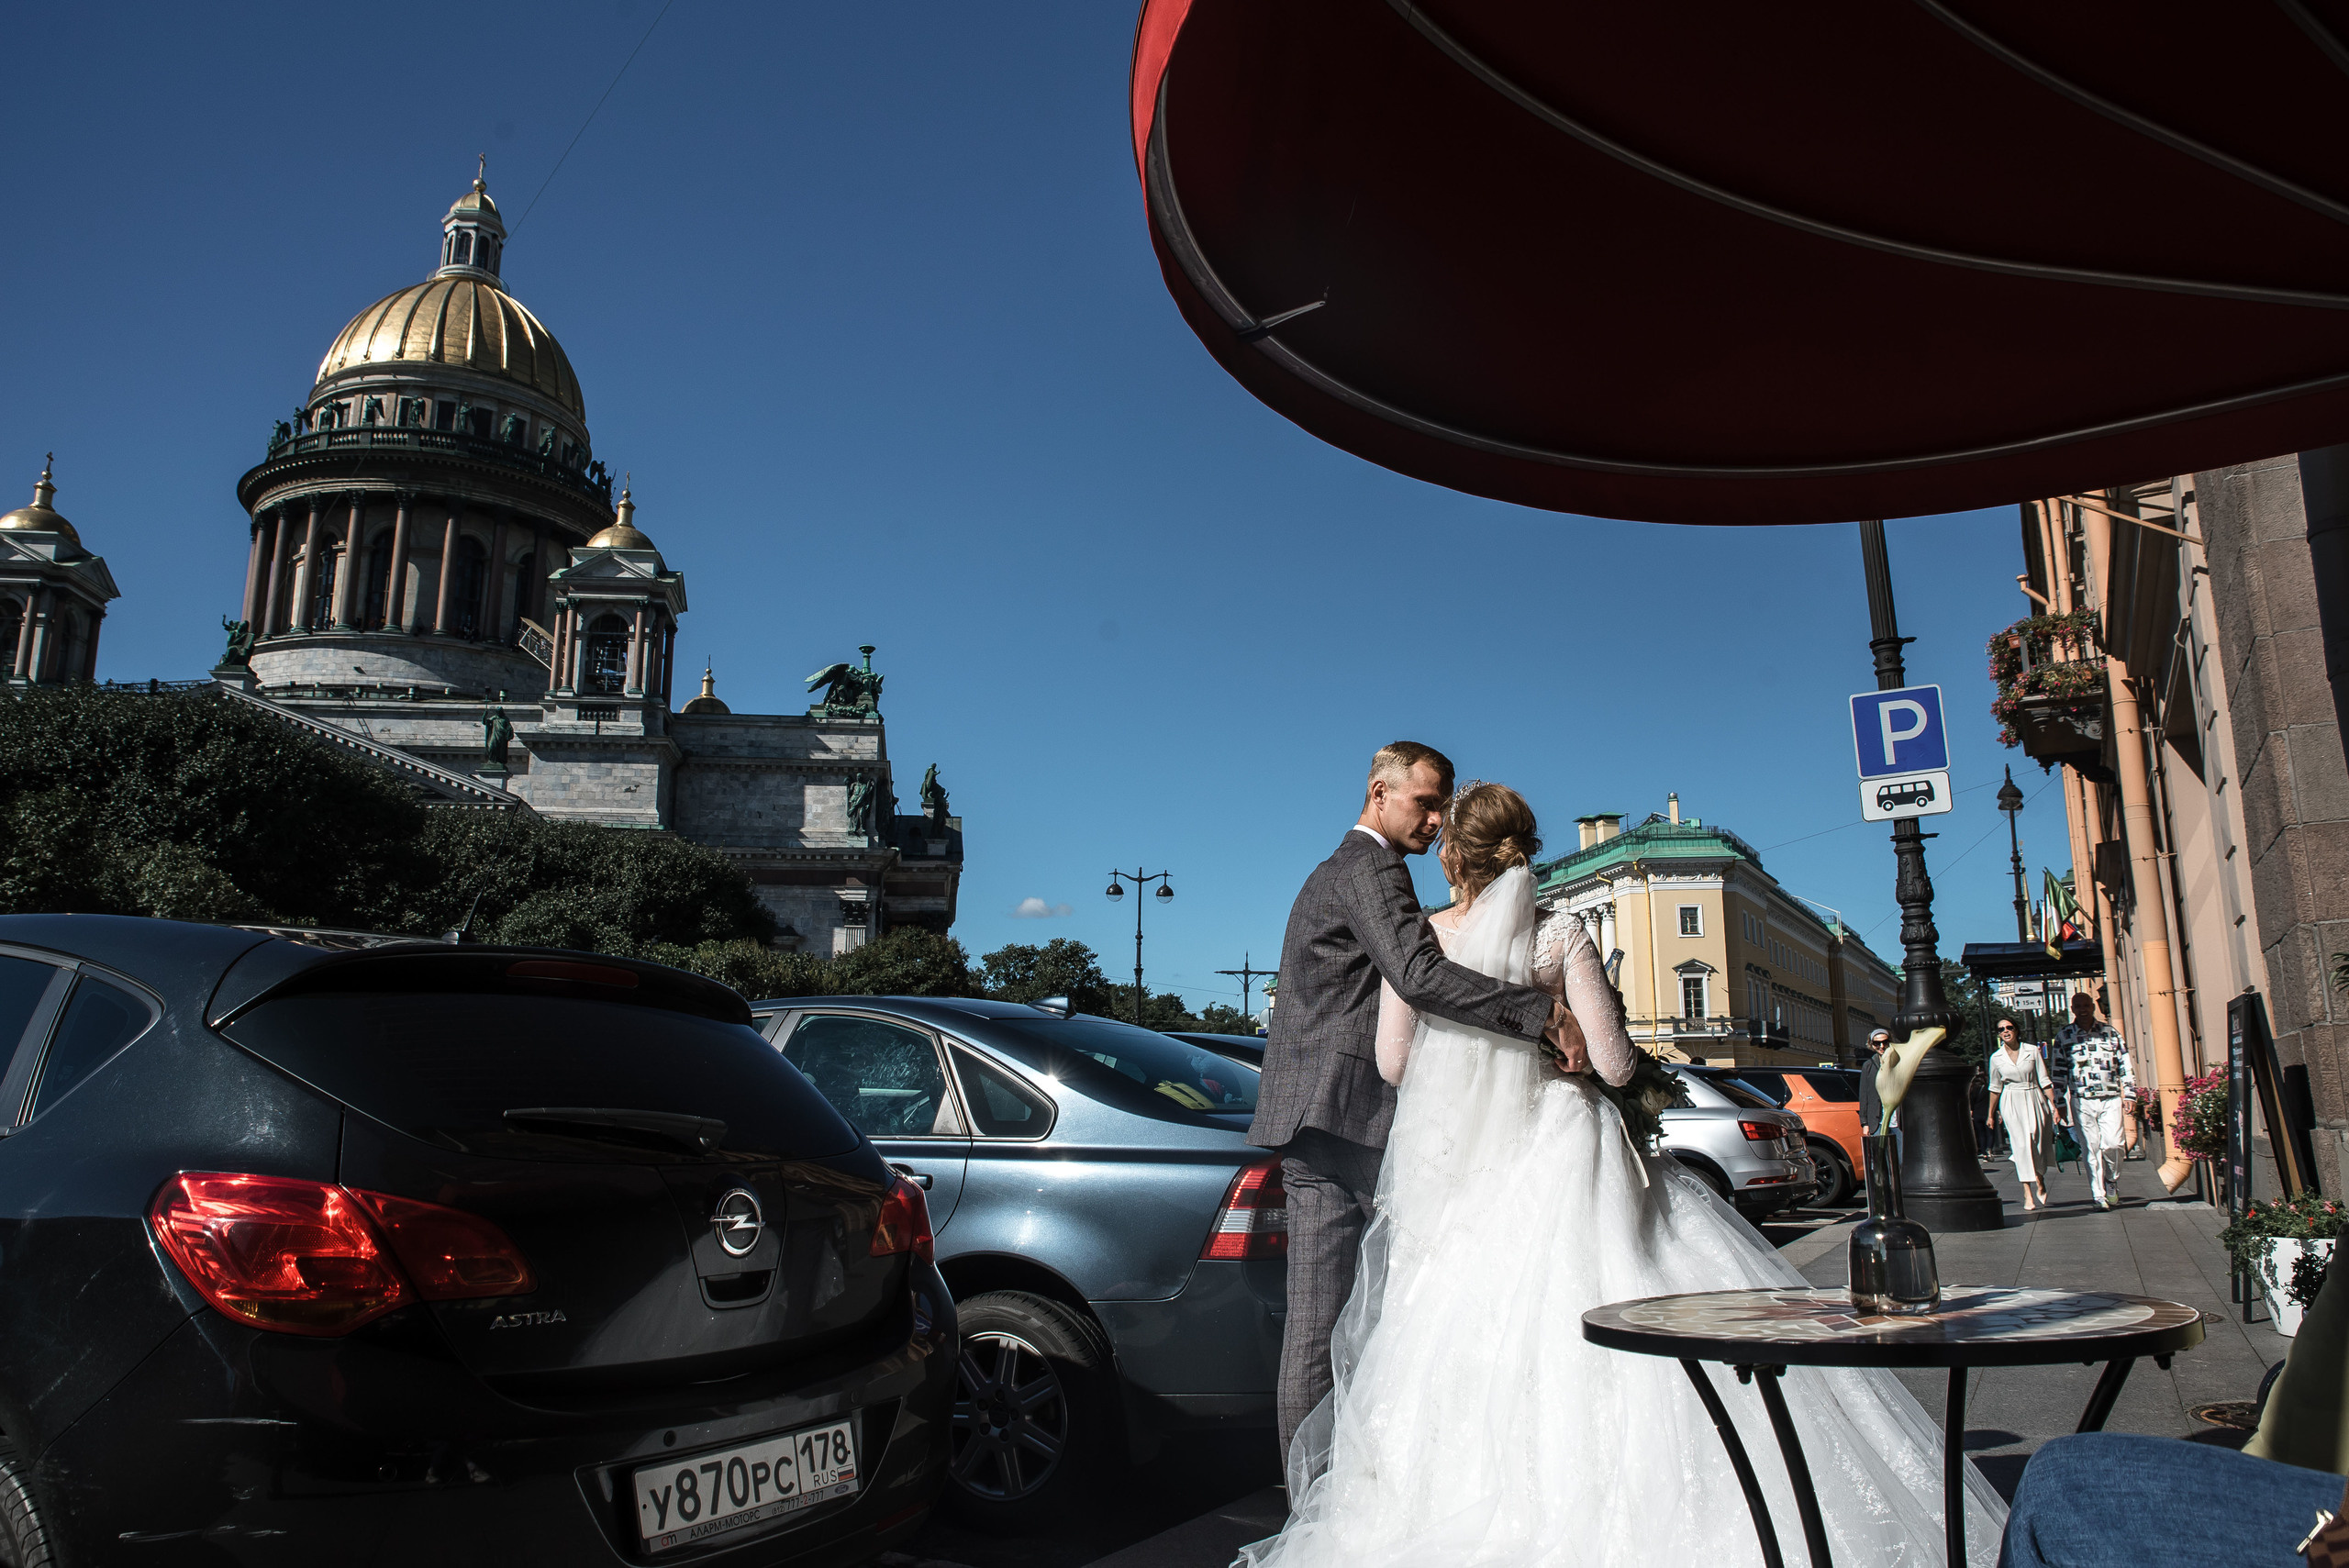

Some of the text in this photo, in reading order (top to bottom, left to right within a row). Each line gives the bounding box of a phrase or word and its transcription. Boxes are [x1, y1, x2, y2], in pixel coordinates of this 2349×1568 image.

[1877, 699, 1928, 766] P
[489, 1308, 567, 1330] ASTRA
[799, 1429, 850, 1473] 178
[813, 1469, 838, 1488] RUS
[786, 1490, 824, 1511] 777-2-777
[690, 1509, 761, 1540] АЛАРМ-МОТОРС
